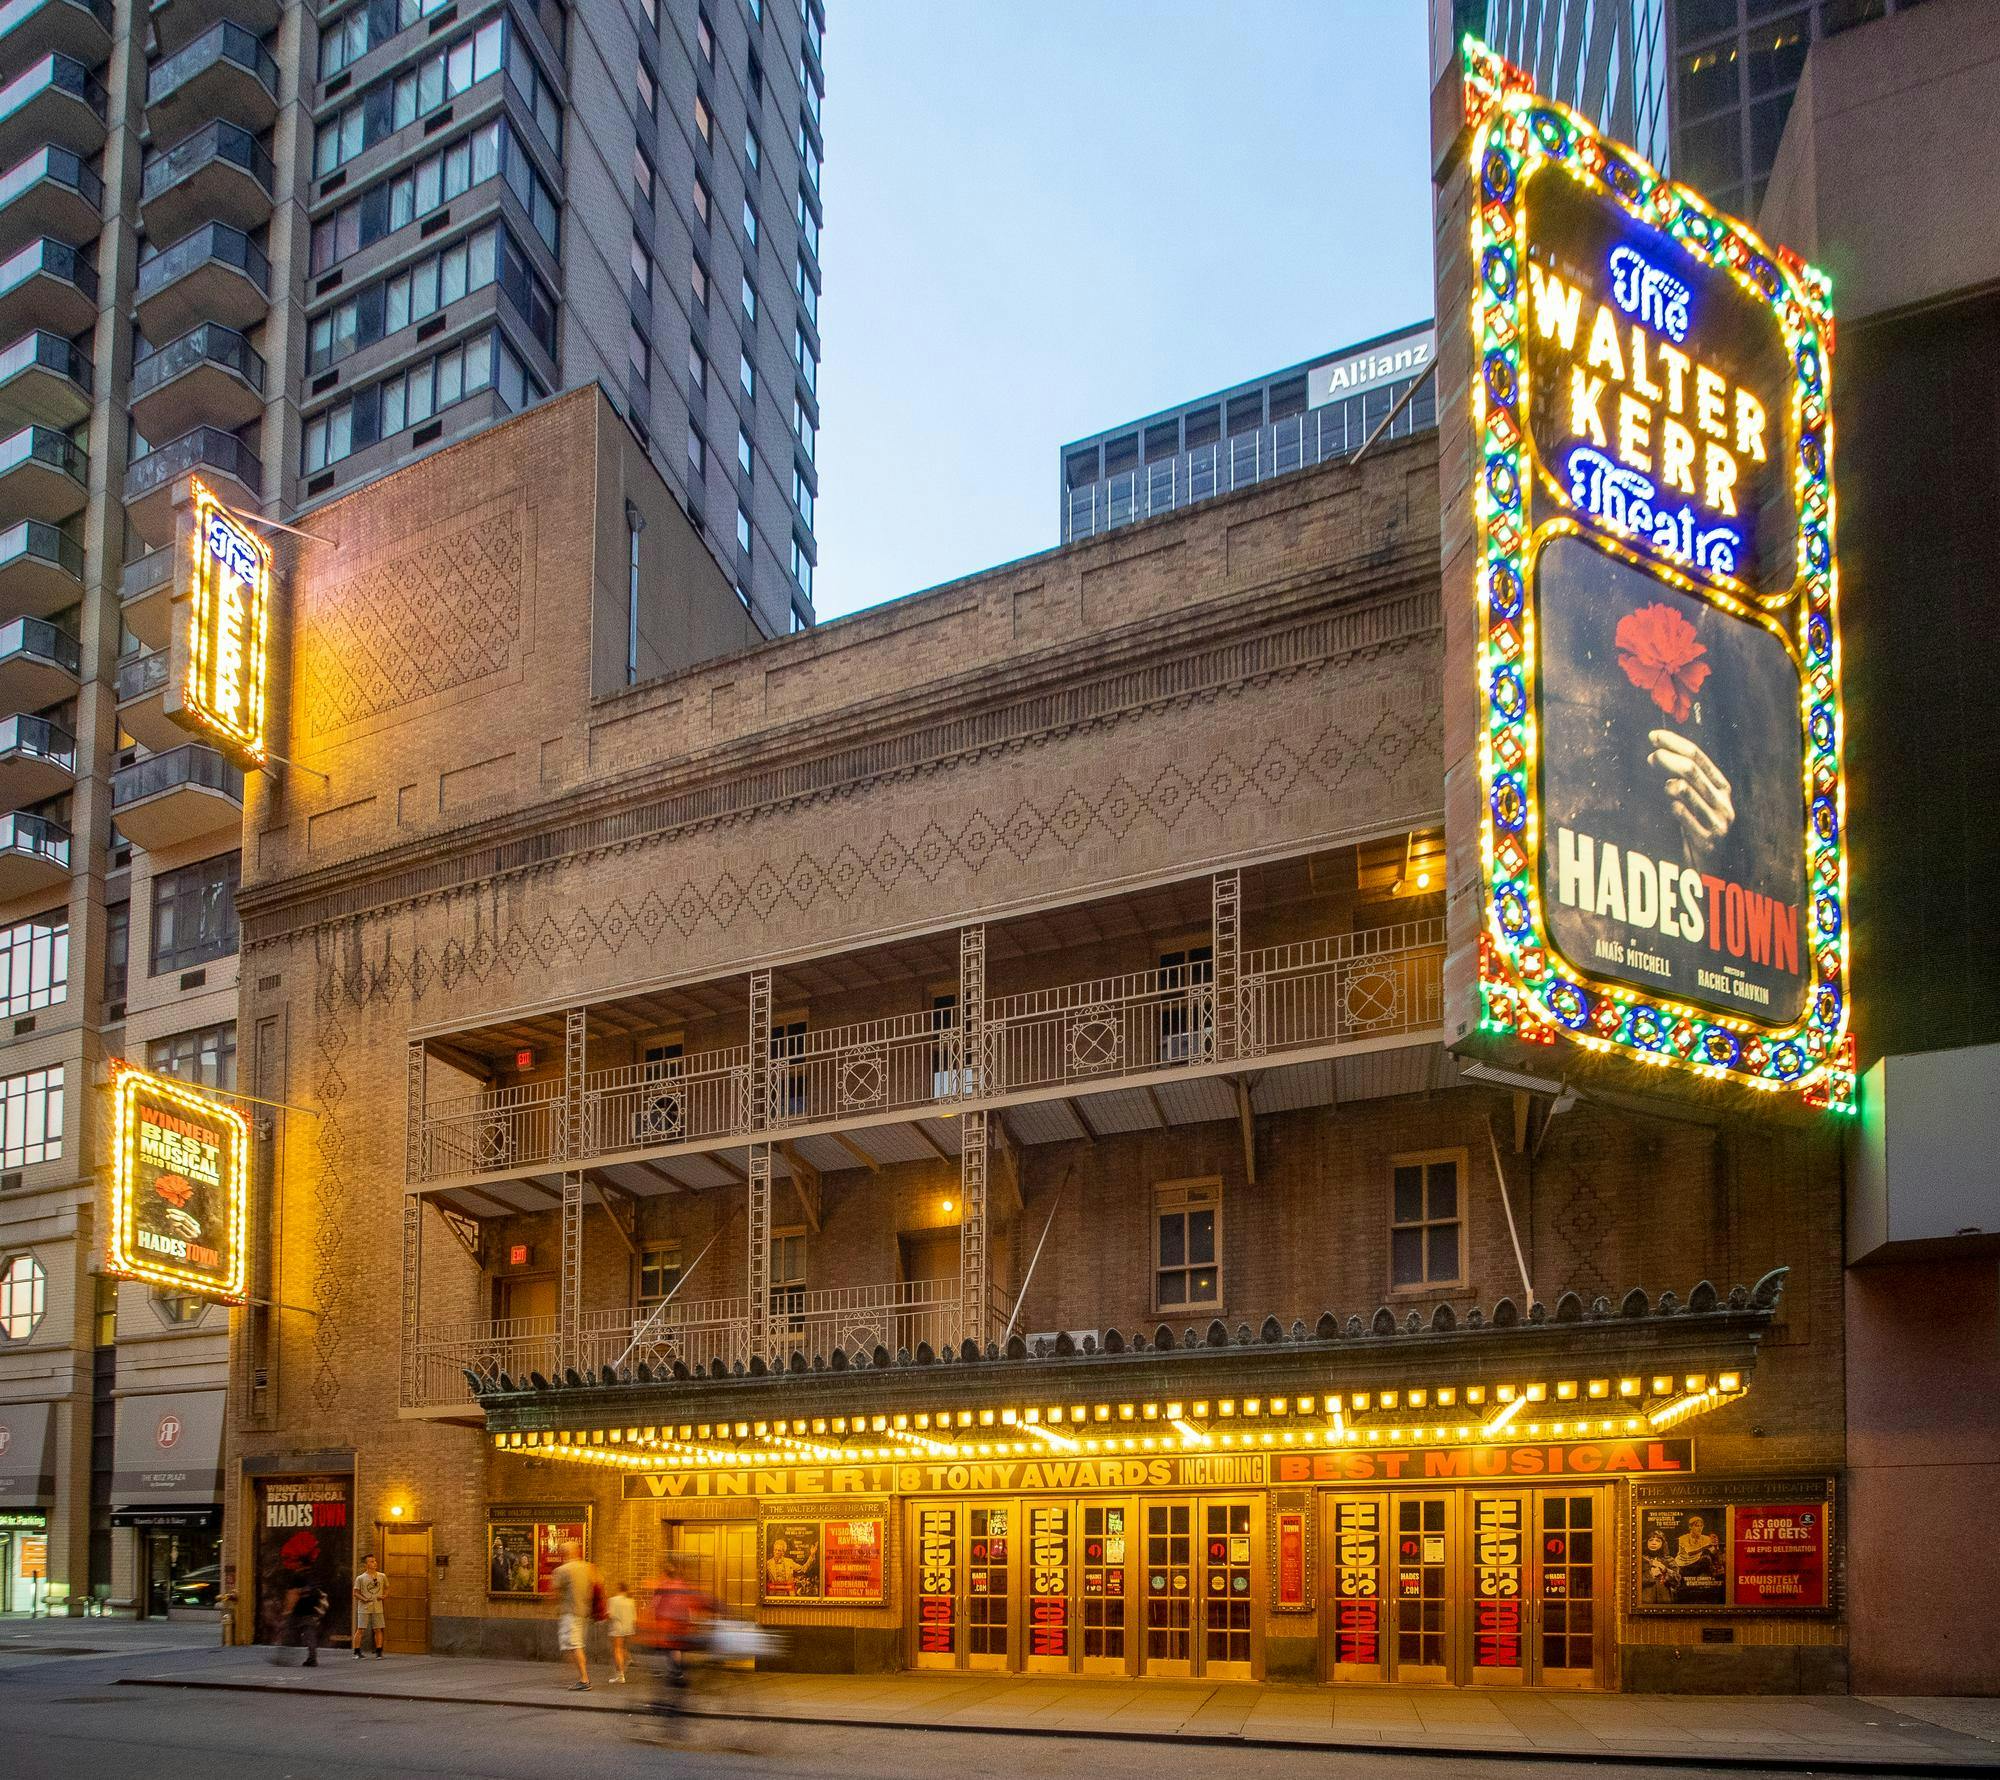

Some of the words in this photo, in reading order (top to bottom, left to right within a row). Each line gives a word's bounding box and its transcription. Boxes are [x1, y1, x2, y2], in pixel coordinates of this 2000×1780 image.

[1610, 247, 1689, 343] The
[1328, 343, 1429, 394] Allianz
[1528, 261, 1766, 462] WALTER
[1571, 364, 1737, 517] KERR
[1568, 447, 1740, 577] Theatre
[215, 562, 246, 724] KERR
[1558, 827, 1798, 975] HADESTOWN
[1627, 948, 1672, 977] MITCHELL
[1698, 969, 1731, 993] RACHEL
[1733, 979, 1769, 1005] CHAVKIN
[140, 1105, 220, 1147] WINNER!
[141, 1121, 220, 1161] BEST
[140, 1153, 164, 1169] 2019
[165, 1161, 190, 1176] TONY
[141, 1137, 220, 1179] MUSICAL
[138, 1230, 218, 1266] HADESTOWN
[900, 1467, 921, 1491] 8
[927, 1465, 1020, 1490] TONY
[1179, 1457, 1262, 1485] INCLUDING
[1280, 1453, 1410, 1482] BEST
[1424, 1444, 1681, 1477] MUSICAL
[267, 1492, 295, 1502] BEST
[296, 1491, 346, 1501] MUSICAL
[644, 1469, 882, 1497] WINNER!
[1640, 1486, 1664, 1496] THE
[1670, 1485, 1718, 1495] WALTER
[266, 1503, 346, 1528] HADESTOWN
[769, 1505, 784, 1513] THE
[786, 1504, 816, 1513] WALTER
[820, 1504, 839, 1512] KERR
[844, 1503, 879, 1512] THEATRE
[1752, 1520, 1765, 1528] AS
[1767, 1519, 1793, 1528] GOOD
[1745, 1528, 1760, 1539] AS
[1763, 1528, 1775, 1539] IT
[923, 1511, 951, 1652] HADESTOWN
[1034, 1509, 1064, 1655] HADESTOWN
[1341, 1504, 1376, 1663] HADESTOWN
[1480, 1501, 1518, 1665] HADESTOWN
[1738, 1575, 1799, 1585] EXQUISITELY
[1759, 1584, 1804, 1594] ORIGINAL
